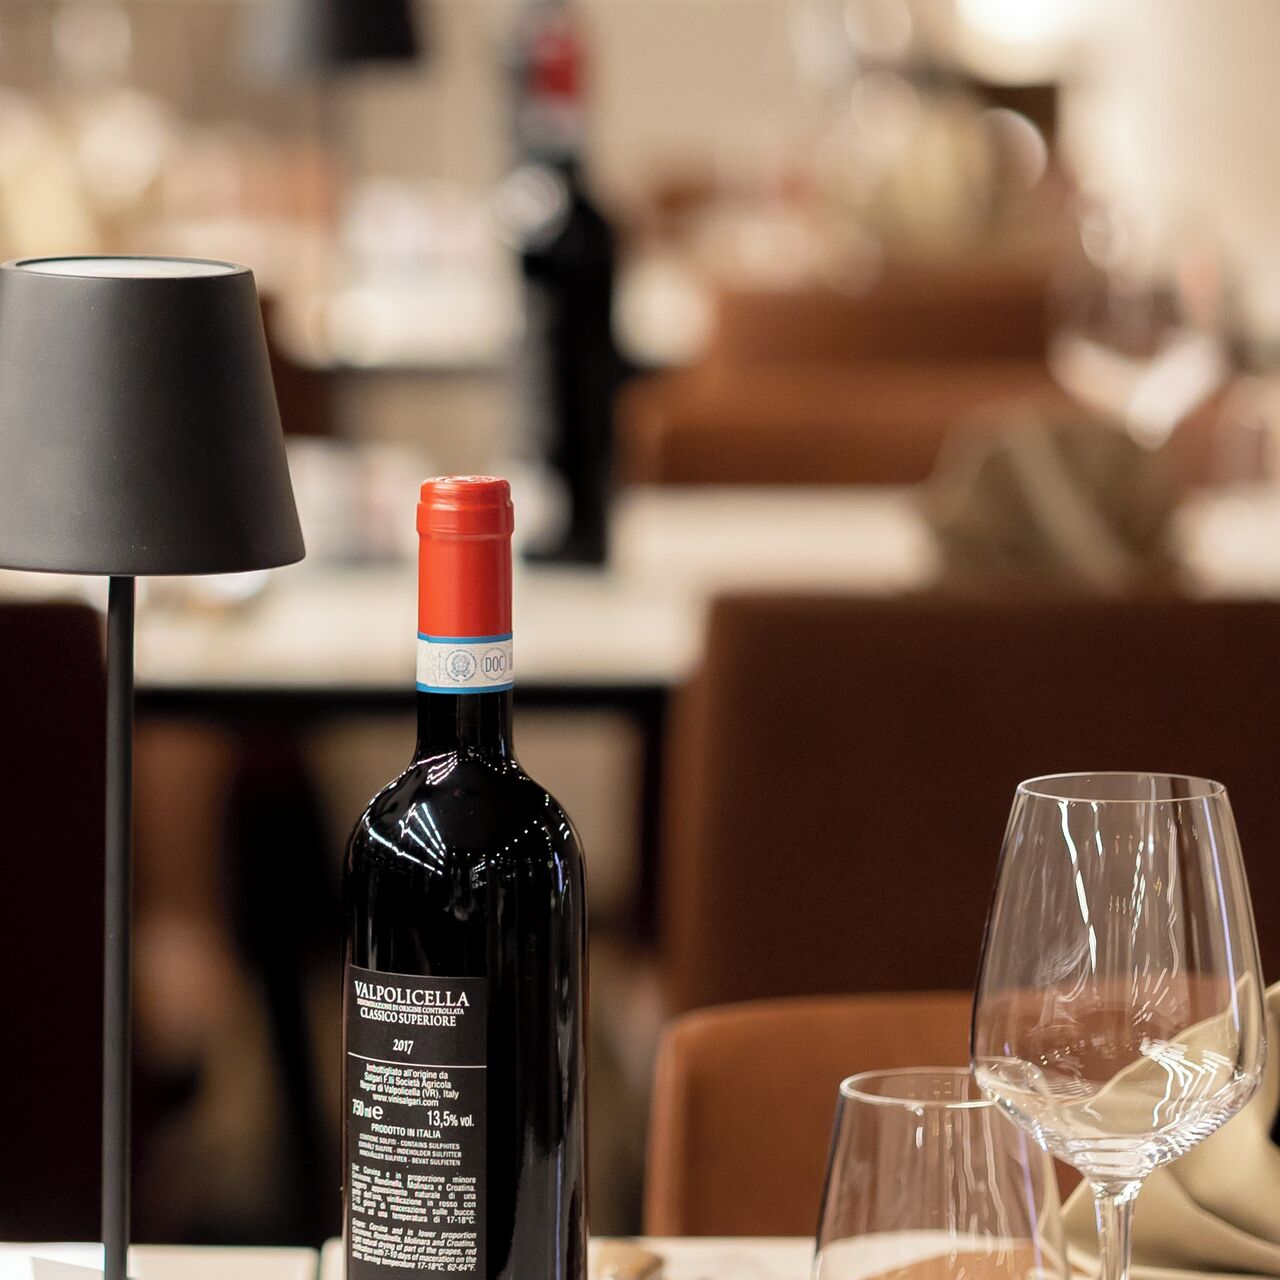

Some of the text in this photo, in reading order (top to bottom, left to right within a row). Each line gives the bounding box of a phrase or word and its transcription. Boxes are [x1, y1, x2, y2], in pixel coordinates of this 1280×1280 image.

[485, 655, 504, 672] DOC
[354, 980, 470, 1007] VALPOLICELLA
[360, 1007, 456, 1026] CLASSICO SUPERIORE
[422, 1006, 464, 1015] CONTROLLATA
[393, 1039, 414, 1055] 2017
[395, 1077, 420, 1088] Società
[421, 1081, 451, 1089] Agricola
[384, 1084, 420, 1097] Valpolicella
[443, 1090, 459, 1100] Italy
[427, 1110, 474, 1128] 13,5% vol.
[371, 1123, 406, 1136] PRODOTTO
[417, 1129, 441, 1138] ITALIA
[429, 1142, 460, 1150] SULPHITES
[407, 1174, 445, 1184] proporzione
[453, 1175, 476, 1183] minore
[441, 1232, 477, 1240] proportion
